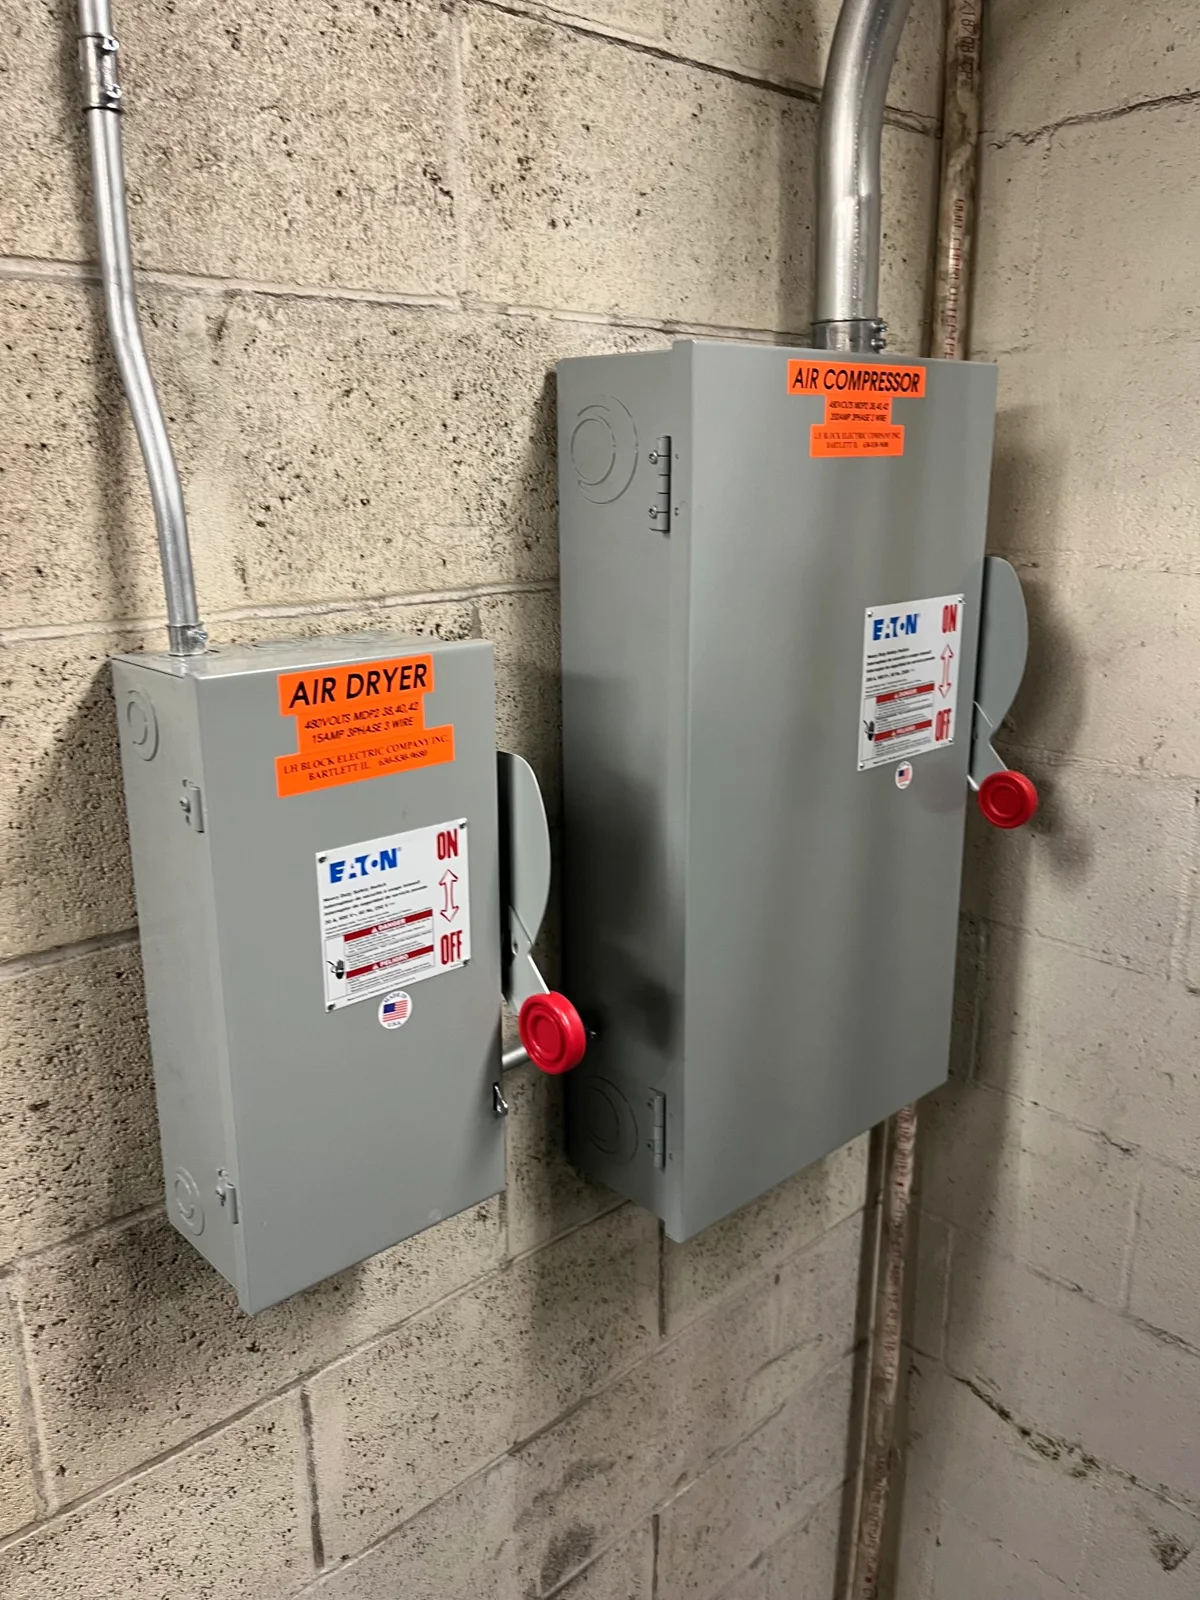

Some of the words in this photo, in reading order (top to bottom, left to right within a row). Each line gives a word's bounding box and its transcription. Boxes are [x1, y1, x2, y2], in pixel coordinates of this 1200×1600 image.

[792, 367, 819, 389] AIR
[823, 368, 920, 393] COMPRESSOR
[873, 613, 918, 641] EATON
[942, 604, 958, 633] ON
[288, 677, 336, 708] AIR
[346, 663, 427, 699] DRYER
[392, 717, 415, 728] WIRE
[935, 708, 952, 741] OFF
[300, 757, 335, 772] BLOCK
[337, 746, 386, 763] ELECTRIC
[386, 739, 431, 755] COMPANY
[308, 763, 359, 781] BARTLETT
[436, 828, 459, 861] ON
[329, 847, 398, 884] EATON
[378, 918, 407, 932] DANGER
[440, 930, 463, 967] OFF
